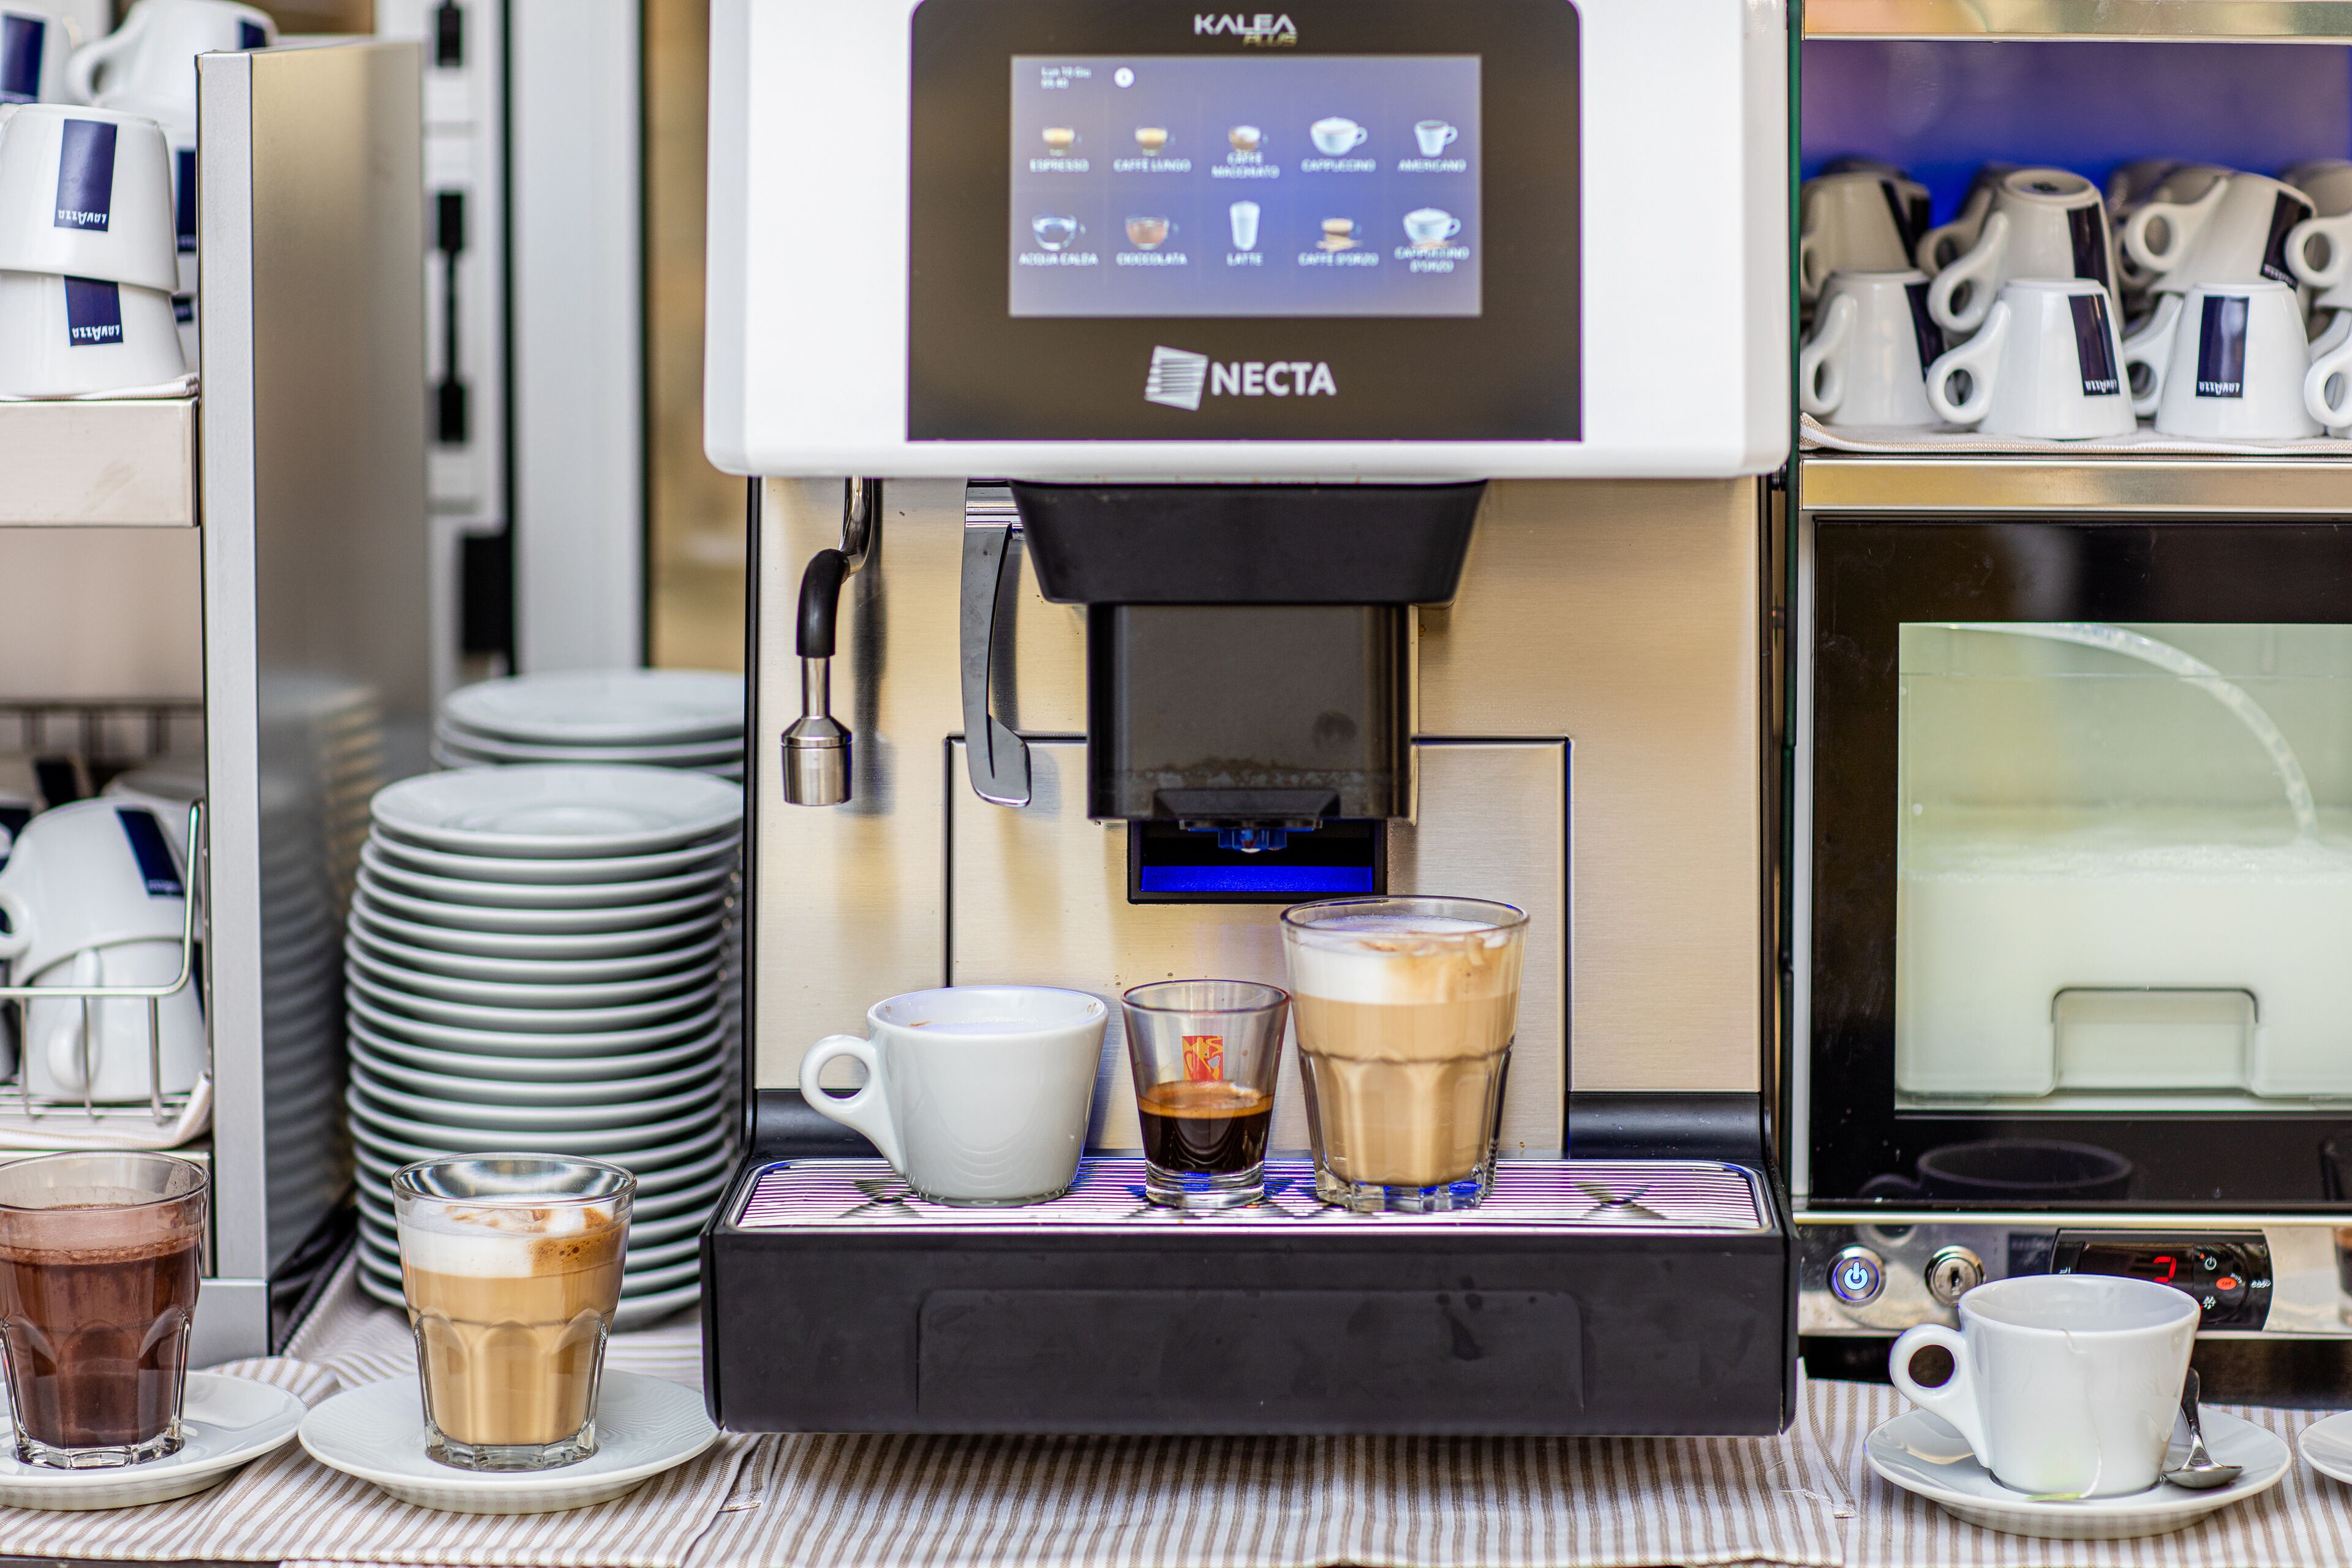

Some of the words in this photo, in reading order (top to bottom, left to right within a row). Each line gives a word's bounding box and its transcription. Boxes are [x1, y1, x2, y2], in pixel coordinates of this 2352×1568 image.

[1194, 13, 1297, 35] KALEA
[1030, 159, 1090, 172] ESPRESSO
[1150, 159, 1192, 172] LUNGO
[1211, 165, 1280, 178] MACCHIATO
[1301, 159, 1376, 172] CAPPUCCINO
[1397, 159, 1466, 172] AMERICANO
[58, 209, 107, 225] LAVAZZA
[1018, 252, 1059, 266] ACQUA
[1060, 252, 1099, 266] CALDA
[1115, 252, 1188, 266] CIOCCOLATA
[1227, 252, 1264, 266] LATTE
[1393, 246, 1470, 260] CAPPUCCINO
[72, 325, 121, 341] LAVAZZA
[1210, 361, 1338, 396] NECTA
